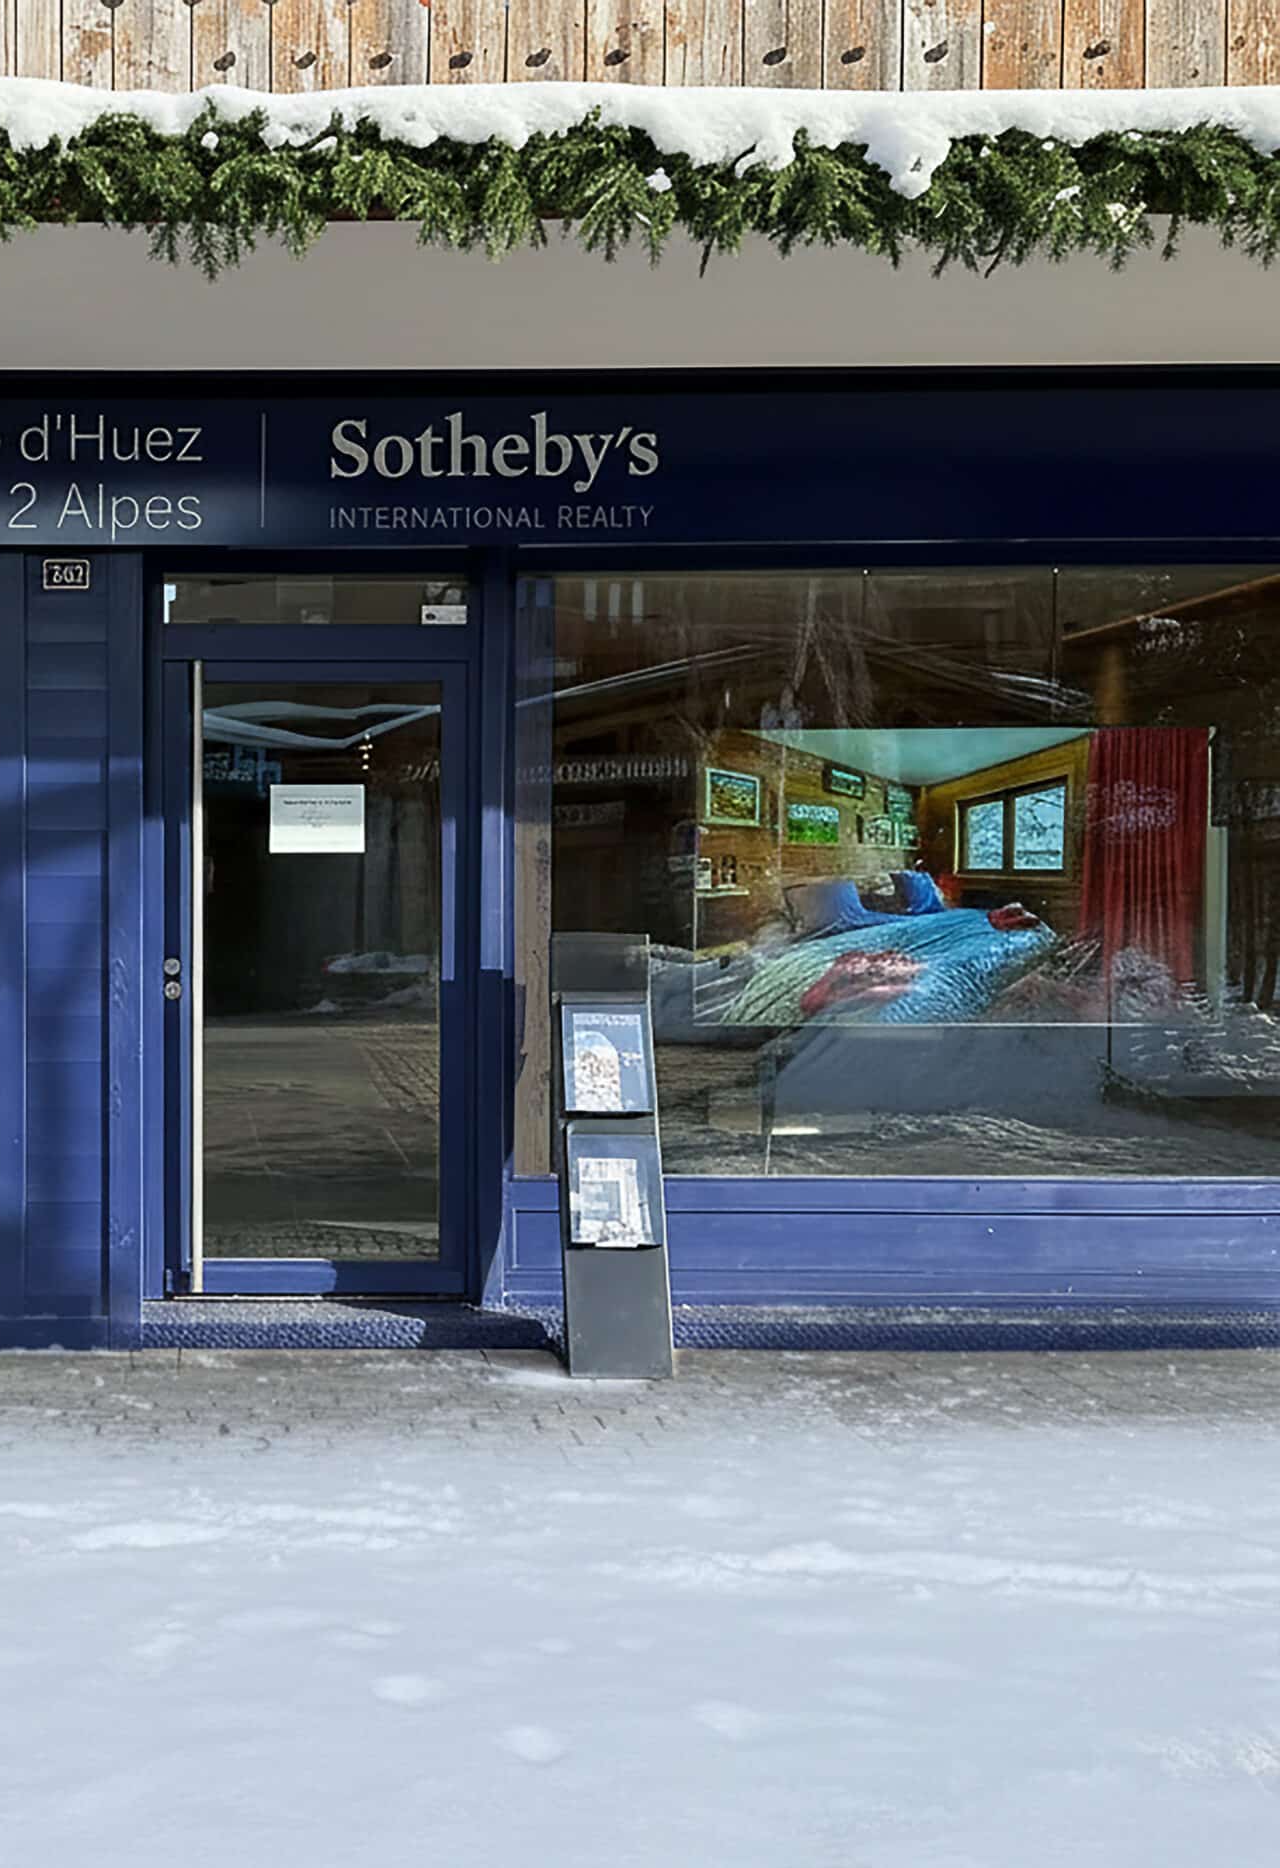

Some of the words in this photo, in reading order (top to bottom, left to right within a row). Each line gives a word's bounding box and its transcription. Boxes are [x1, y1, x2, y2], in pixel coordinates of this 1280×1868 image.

[20, 413, 203, 462] d'Huez
[331, 412, 660, 494] Sotheby's
[8, 483, 39, 529] 2
[57, 482, 202, 542] Alpes
[330, 506, 546, 531] INTERNATIONAL
[557, 506, 655, 529] REALTY
